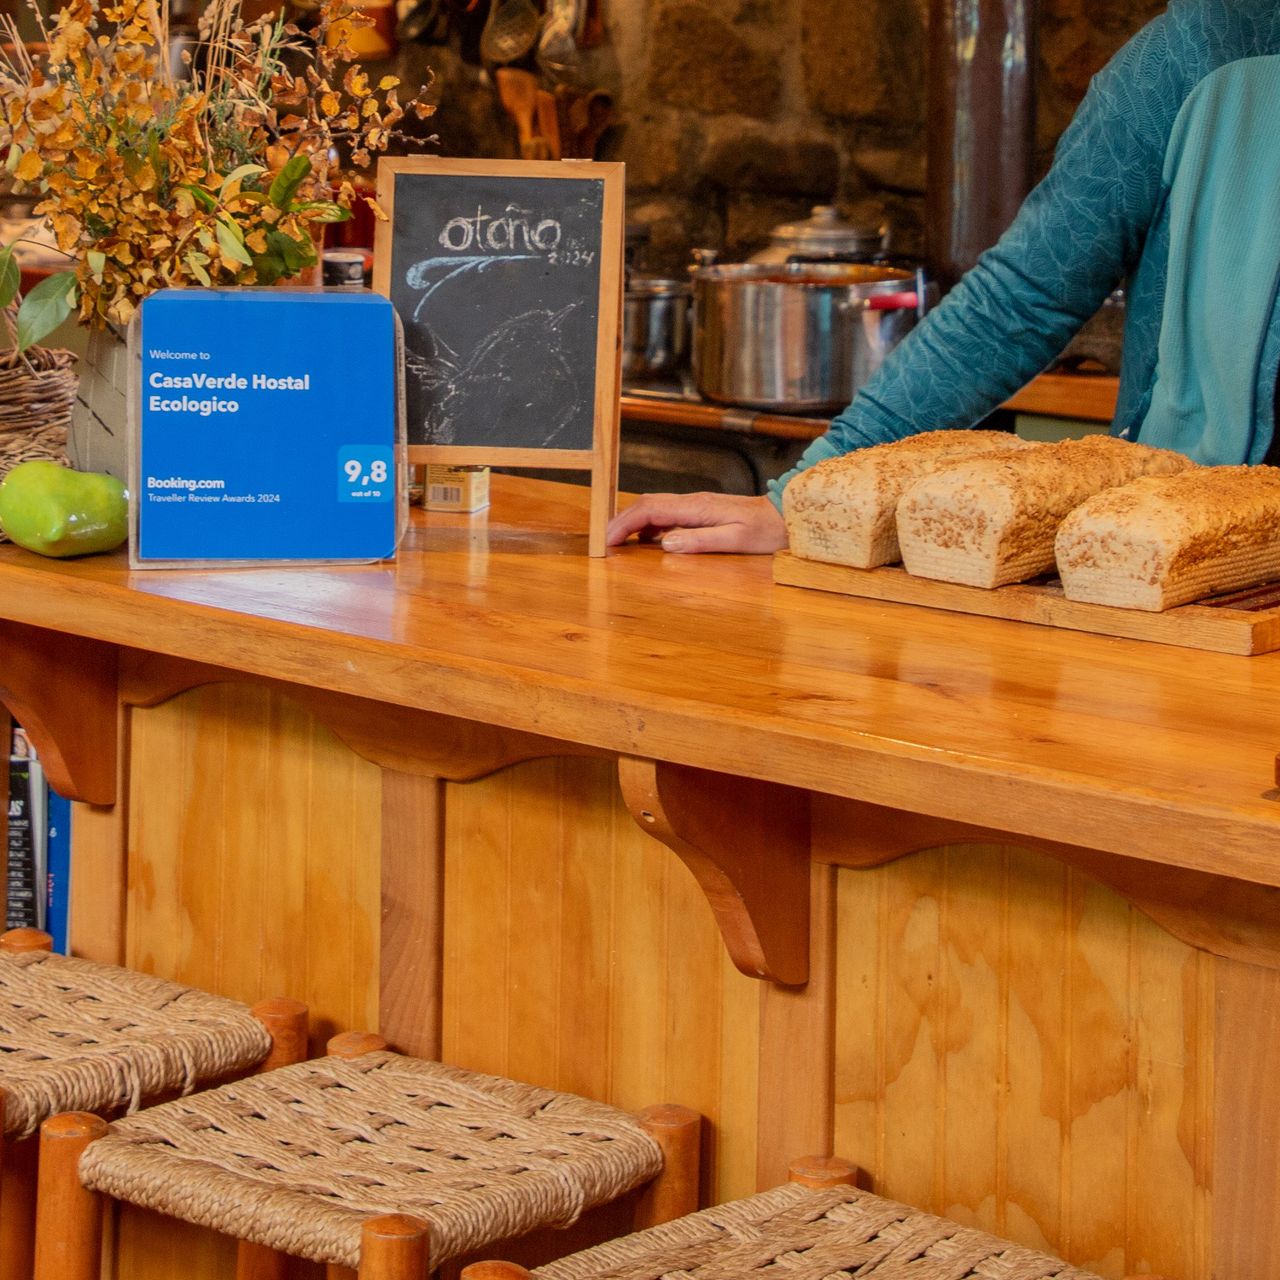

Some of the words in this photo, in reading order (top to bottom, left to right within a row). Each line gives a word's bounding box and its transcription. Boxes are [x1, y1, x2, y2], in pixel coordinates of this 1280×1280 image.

[149, 349, 197, 360] Welcome
[199, 351, 211, 360] to
[149, 372, 248, 389] CasaVerde
[252, 374, 310, 390] Hostal
[149, 395, 239, 416] Ecologico
[344, 460, 387, 486] 9,8
[147, 477, 225, 491] Booking.com
[148, 493, 186, 503] Traveller
[188, 494, 220, 503] Review
[221, 494, 255, 503] Awards
[257, 494, 280, 503] 2024
